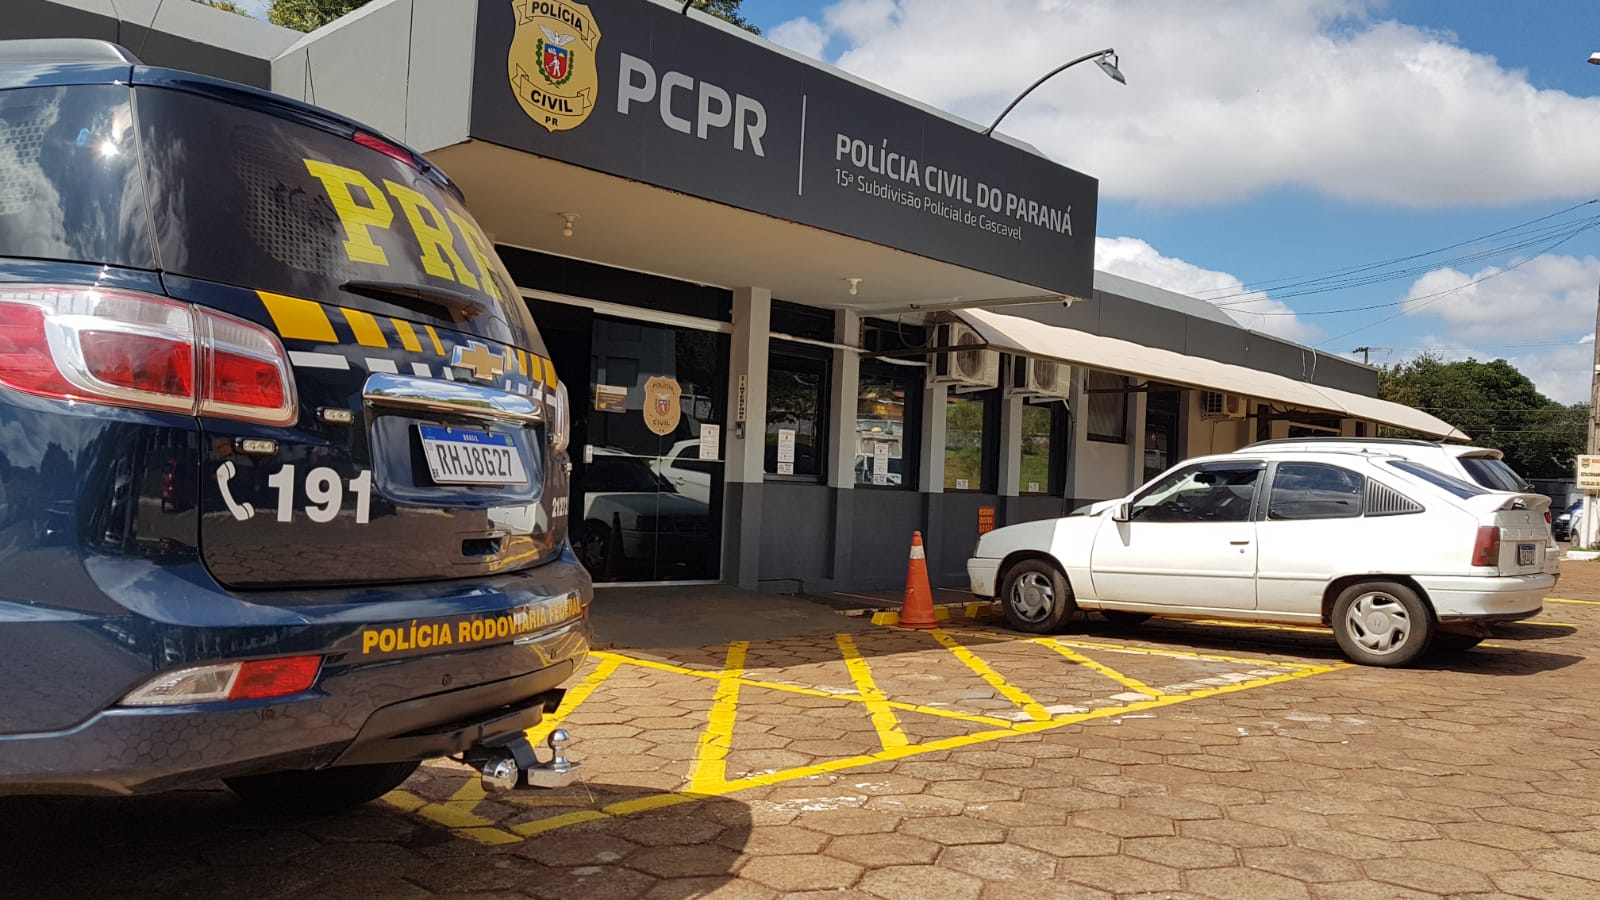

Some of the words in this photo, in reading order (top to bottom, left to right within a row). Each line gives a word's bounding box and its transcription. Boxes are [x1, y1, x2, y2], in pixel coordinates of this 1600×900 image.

[531, 1, 583, 31] POLÍCIA
[530, 89, 573, 113] CIVIL
[545, 116, 559, 126] PR
[617, 51, 768, 157] PCPR
[835, 132, 921, 188] POLÍCIA
[924, 165, 973, 205] CIVIL
[977, 182, 1002, 213] DO
[1006, 193, 1073, 237] PARANÁ
[835, 168, 854, 188] 15ª
[857, 175, 921, 209] Subdivisão
[923, 196, 963, 223] Policial
[964, 210, 977, 227] de
[979, 214, 1023, 241] Cascavel
[303, 158, 503, 304] PRF
[652, 419, 671, 427] CIVIL
[435, 443, 513, 478] RHJ8G27
[267, 463, 373, 525] 191
[362, 618, 452, 655] POLÍCIA
[458, 606, 547, 644] RODOVIÁRIA
[549, 596, 582, 624] FEDERAL
